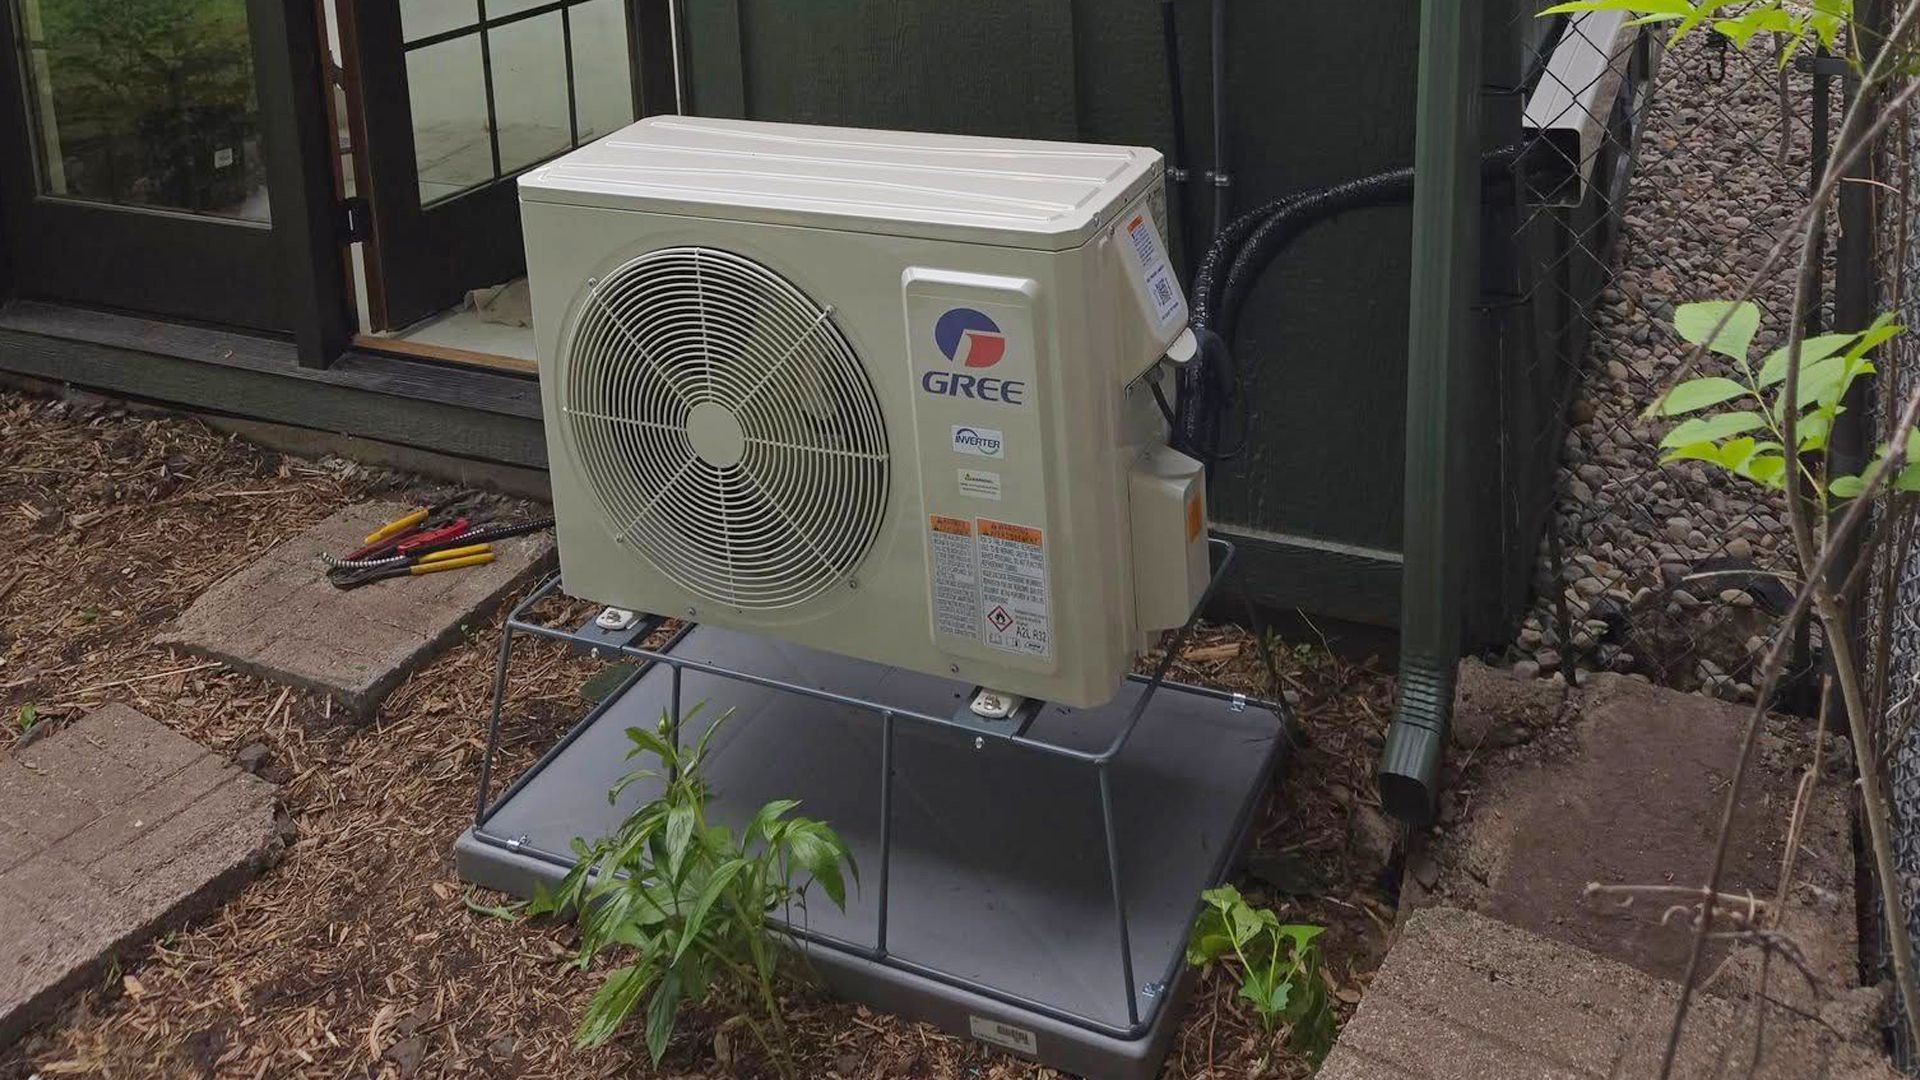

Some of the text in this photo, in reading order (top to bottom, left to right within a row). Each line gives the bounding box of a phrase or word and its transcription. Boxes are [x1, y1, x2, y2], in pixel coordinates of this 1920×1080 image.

[922, 371, 1025, 405] GREE
[955, 435, 1000, 449] INVERTER
[1016, 625, 1046, 643] A2L R32
